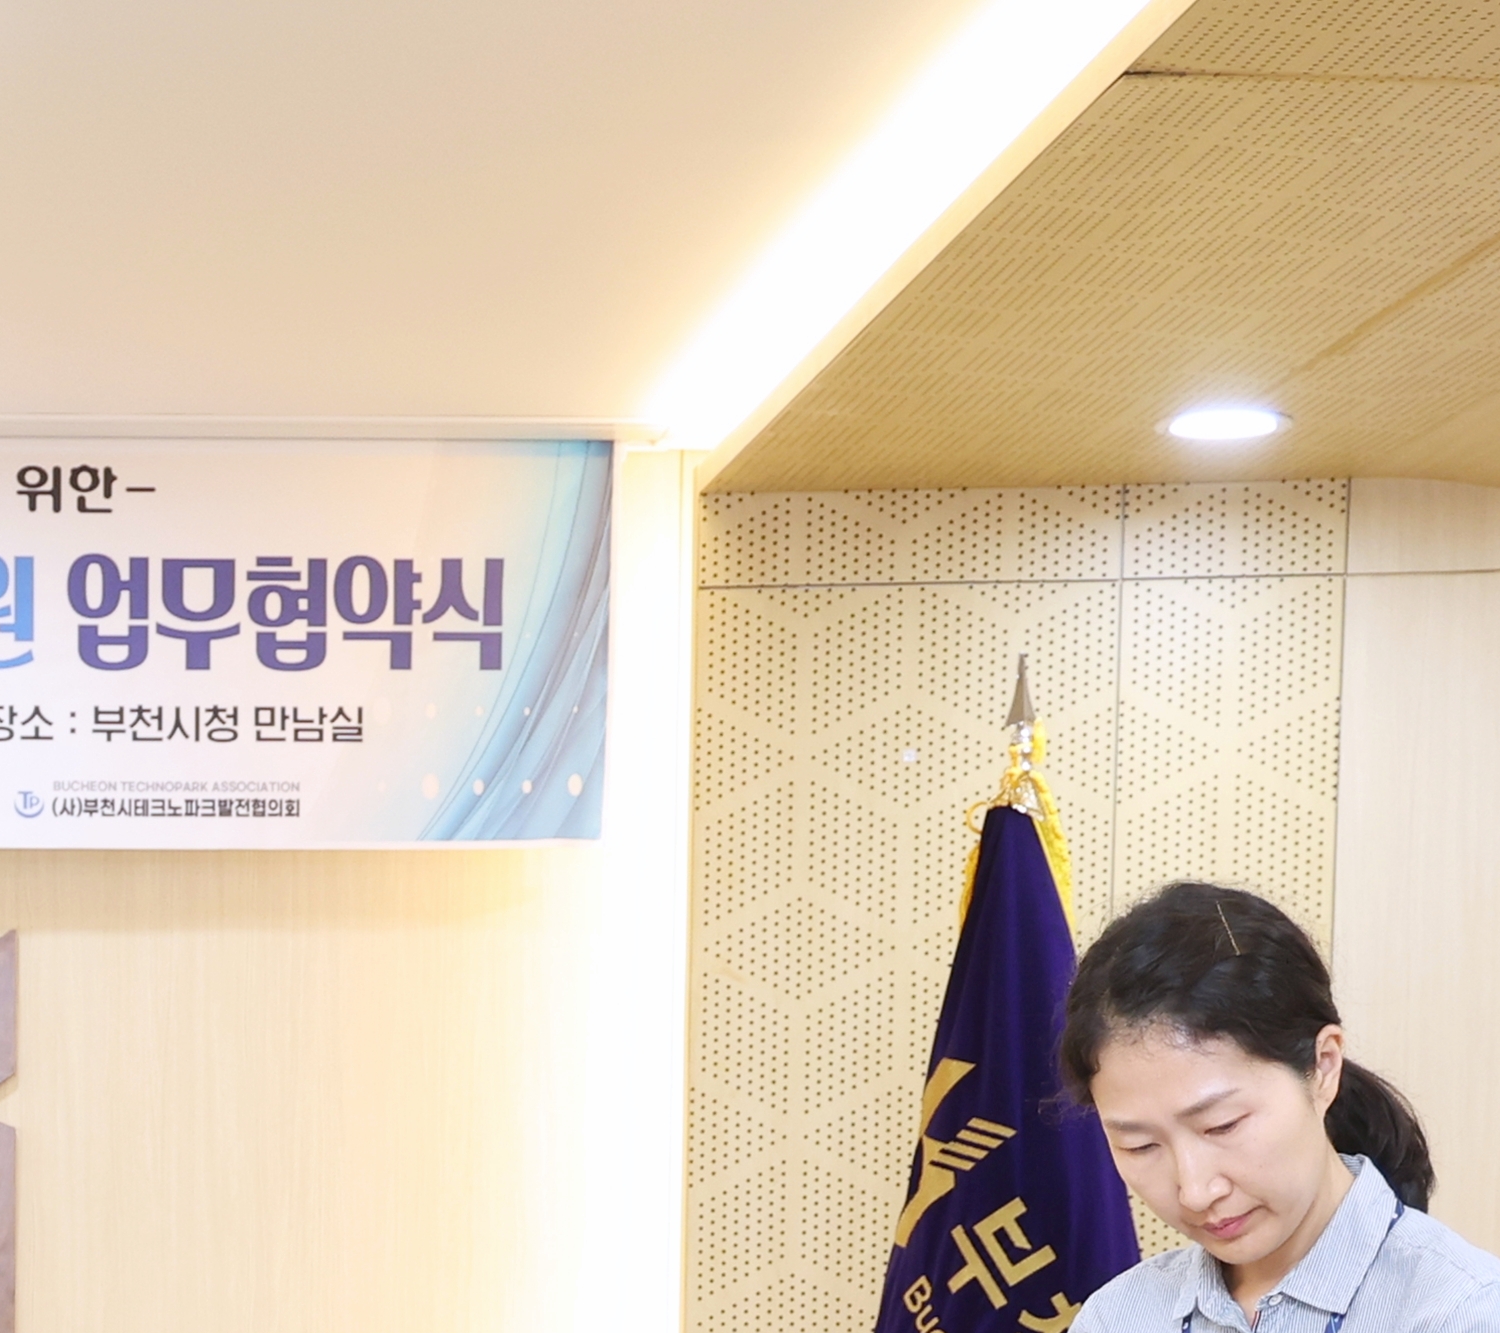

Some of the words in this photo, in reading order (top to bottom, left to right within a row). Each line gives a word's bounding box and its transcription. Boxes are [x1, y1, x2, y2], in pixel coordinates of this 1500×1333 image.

[67, 553, 504, 671] 업무협약식
[93, 705, 238, 742] 부천시청
[255, 707, 363, 742] 만남실
[53, 780, 117, 792] BUCHEON
[121, 780, 207, 793] TECHNOPARK
[212, 780, 300, 793] ASSOCIATION
[52, 798, 300, 817] (사)부천시테크노파크발전협의회
